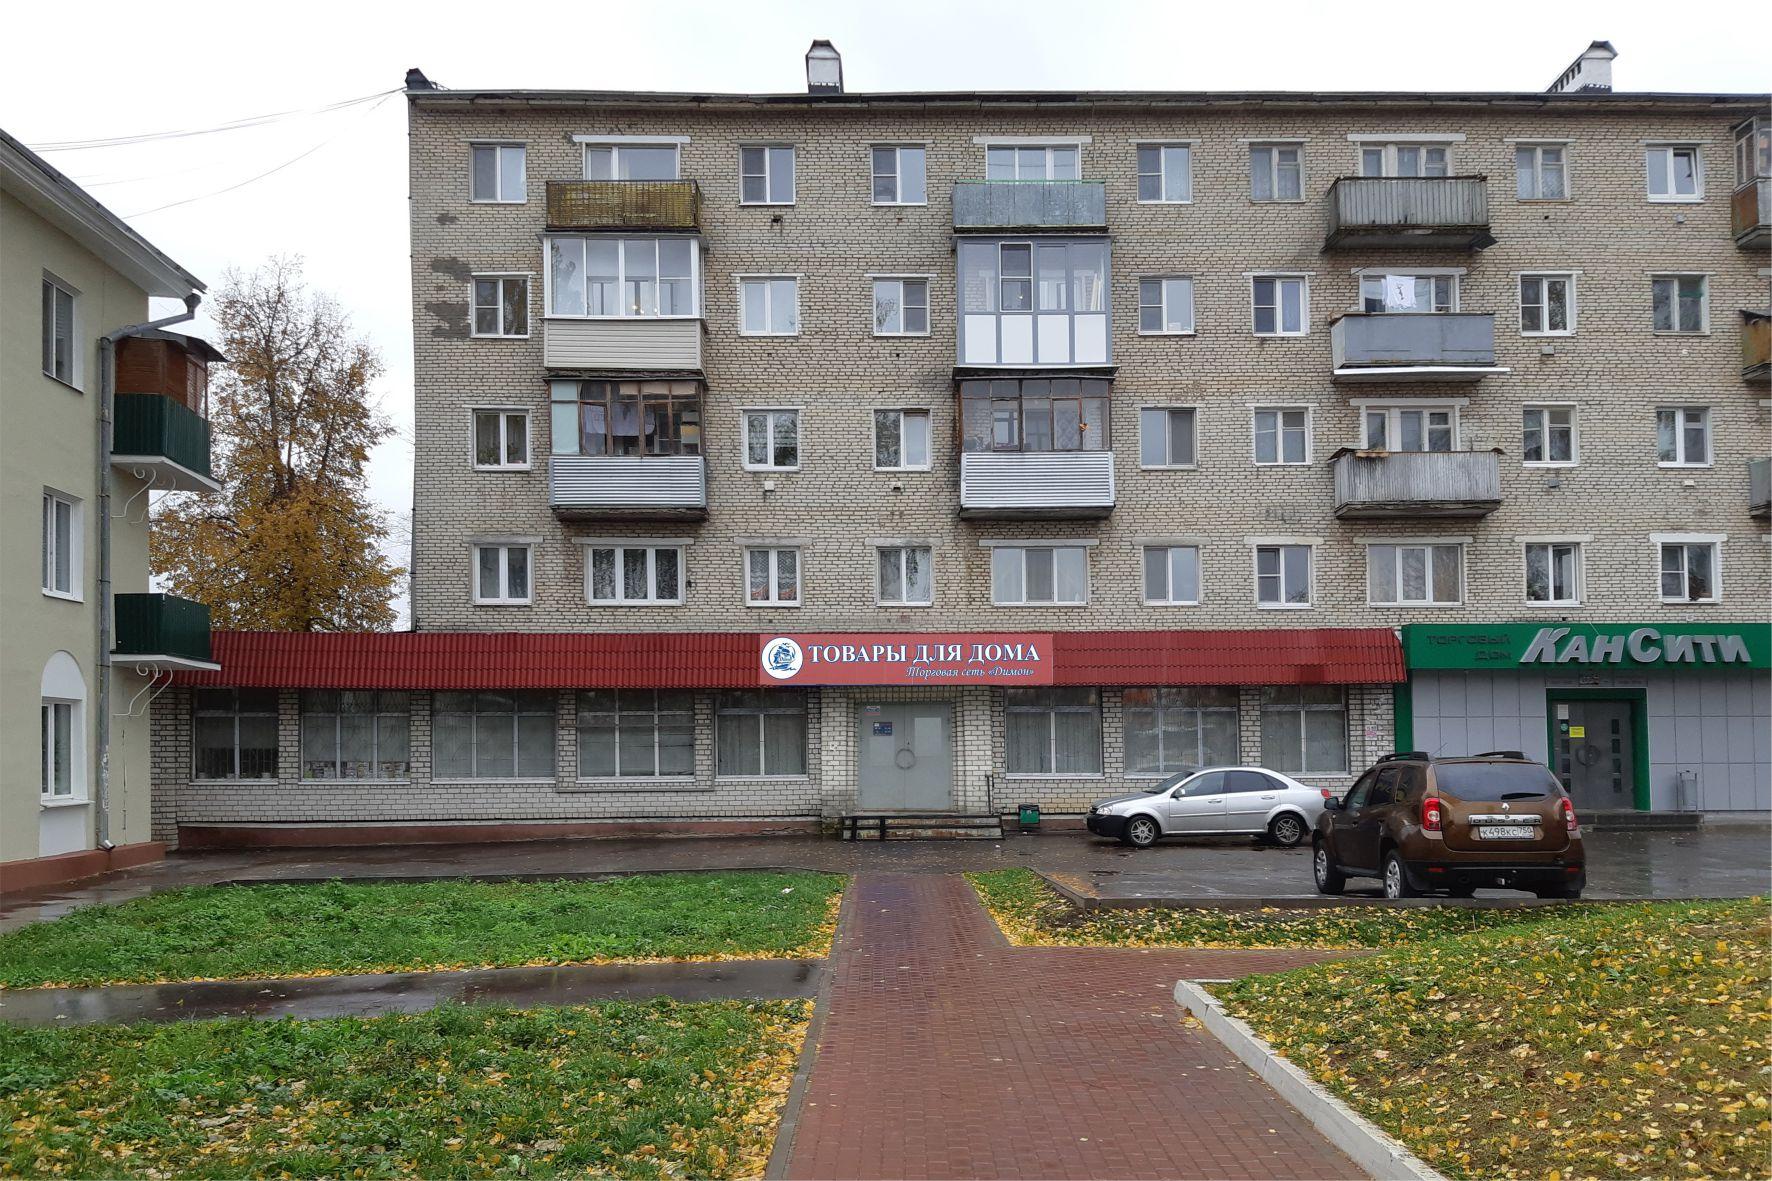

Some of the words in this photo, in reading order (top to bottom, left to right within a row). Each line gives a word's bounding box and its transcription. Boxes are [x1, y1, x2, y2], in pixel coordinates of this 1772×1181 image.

[808, 644, 907, 663] ТОВАРЫ
[912, 644, 962, 665] ДЛЯ
[968, 644, 1041, 665] ДОМА
[905, 666, 958, 680] Торговая
[961, 667, 985, 677] сеть
[988, 666, 1034, 677] «Димон»
